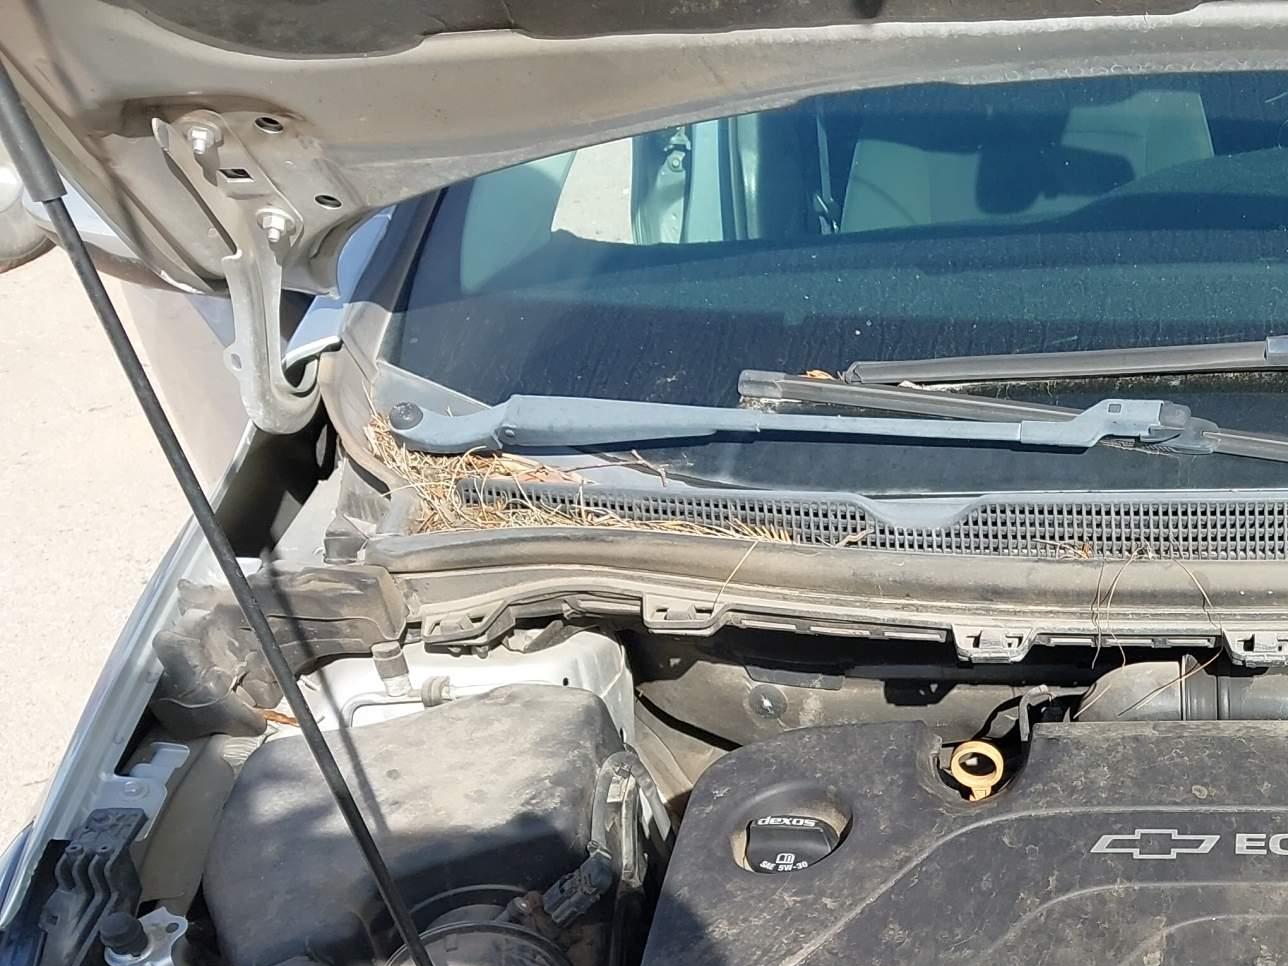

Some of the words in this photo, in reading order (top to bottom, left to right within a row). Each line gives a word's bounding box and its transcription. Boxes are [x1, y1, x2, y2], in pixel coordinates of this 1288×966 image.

[757, 816, 818, 827] dexos
[760, 860, 776, 871] SAE
[778, 860, 809, 872] 5W-30
